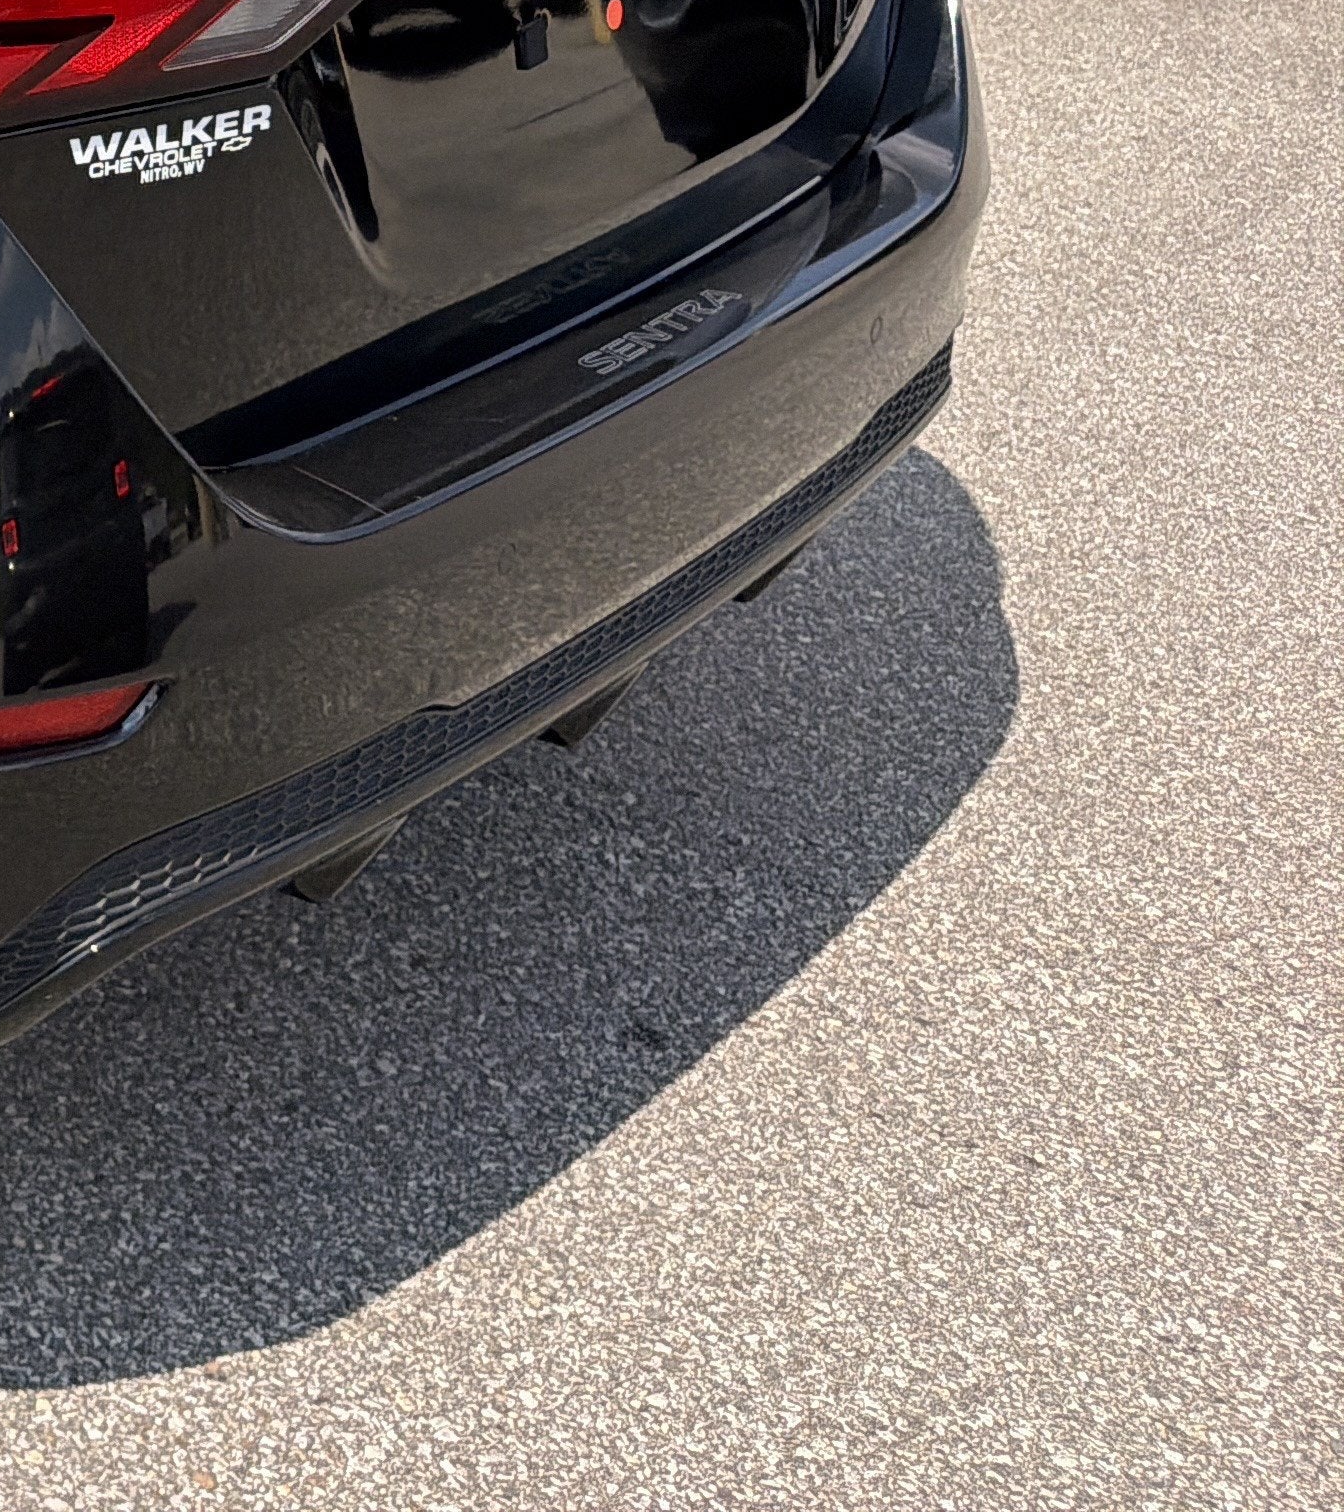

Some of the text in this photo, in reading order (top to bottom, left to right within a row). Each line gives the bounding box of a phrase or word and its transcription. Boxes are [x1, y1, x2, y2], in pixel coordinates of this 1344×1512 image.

[69, 104, 272, 166] WALKER
[88, 141, 218, 179] CHEVROLET
[183, 159, 206, 176] WV
[577, 288, 744, 376] SENTRA
